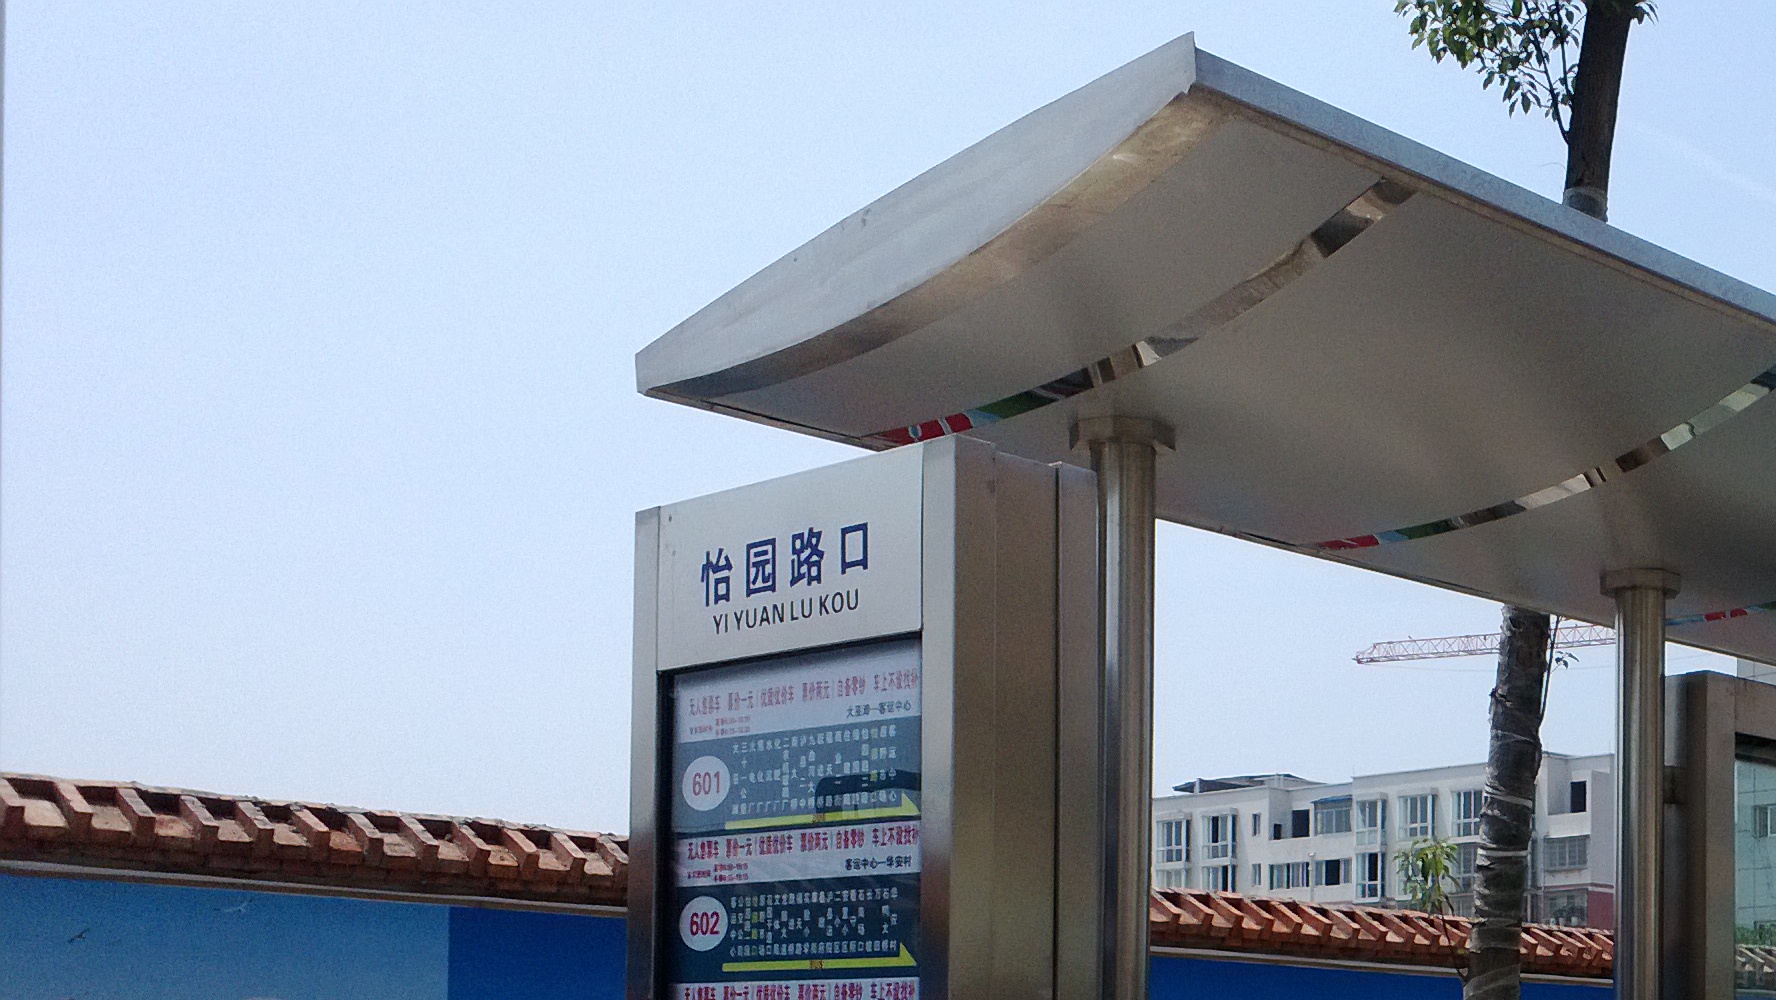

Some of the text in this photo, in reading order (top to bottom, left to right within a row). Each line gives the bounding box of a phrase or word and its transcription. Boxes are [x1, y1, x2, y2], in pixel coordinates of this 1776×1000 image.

[700, 522, 869, 607] 怡园路口
[713, 588, 859, 635] YI YUAN LU KOU
[691, 768, 722, 797] 601
[689, 909, 720, 937] 602
